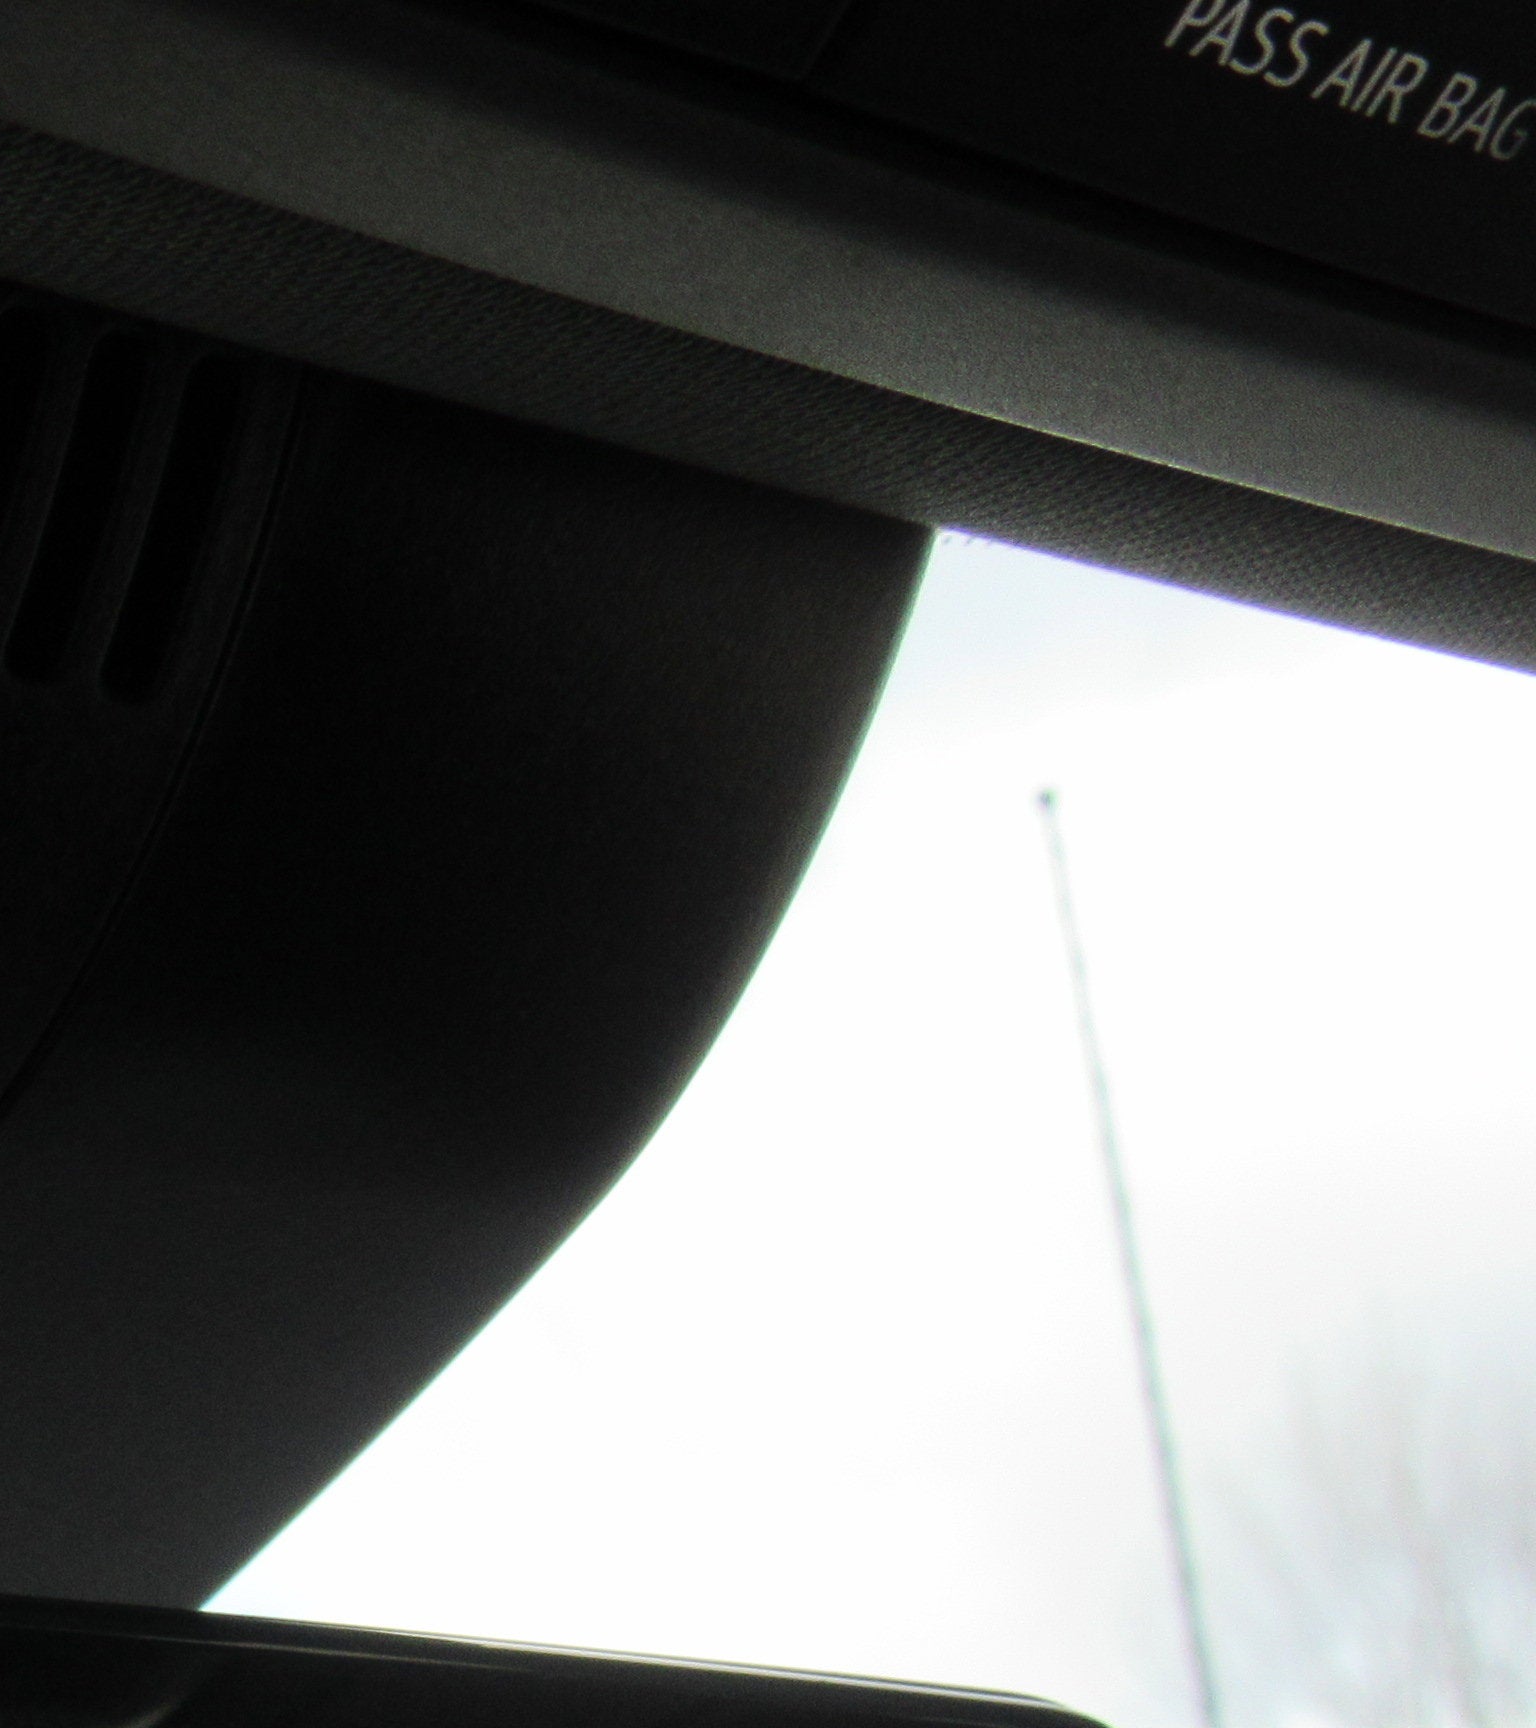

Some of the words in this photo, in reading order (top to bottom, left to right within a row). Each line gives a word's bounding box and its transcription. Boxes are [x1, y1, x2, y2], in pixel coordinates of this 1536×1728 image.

[1164, 0, 1329, 87] PASS
[1309, 37, 1429, 124] AIR
[1416, 71, 1536, 161] BAG
